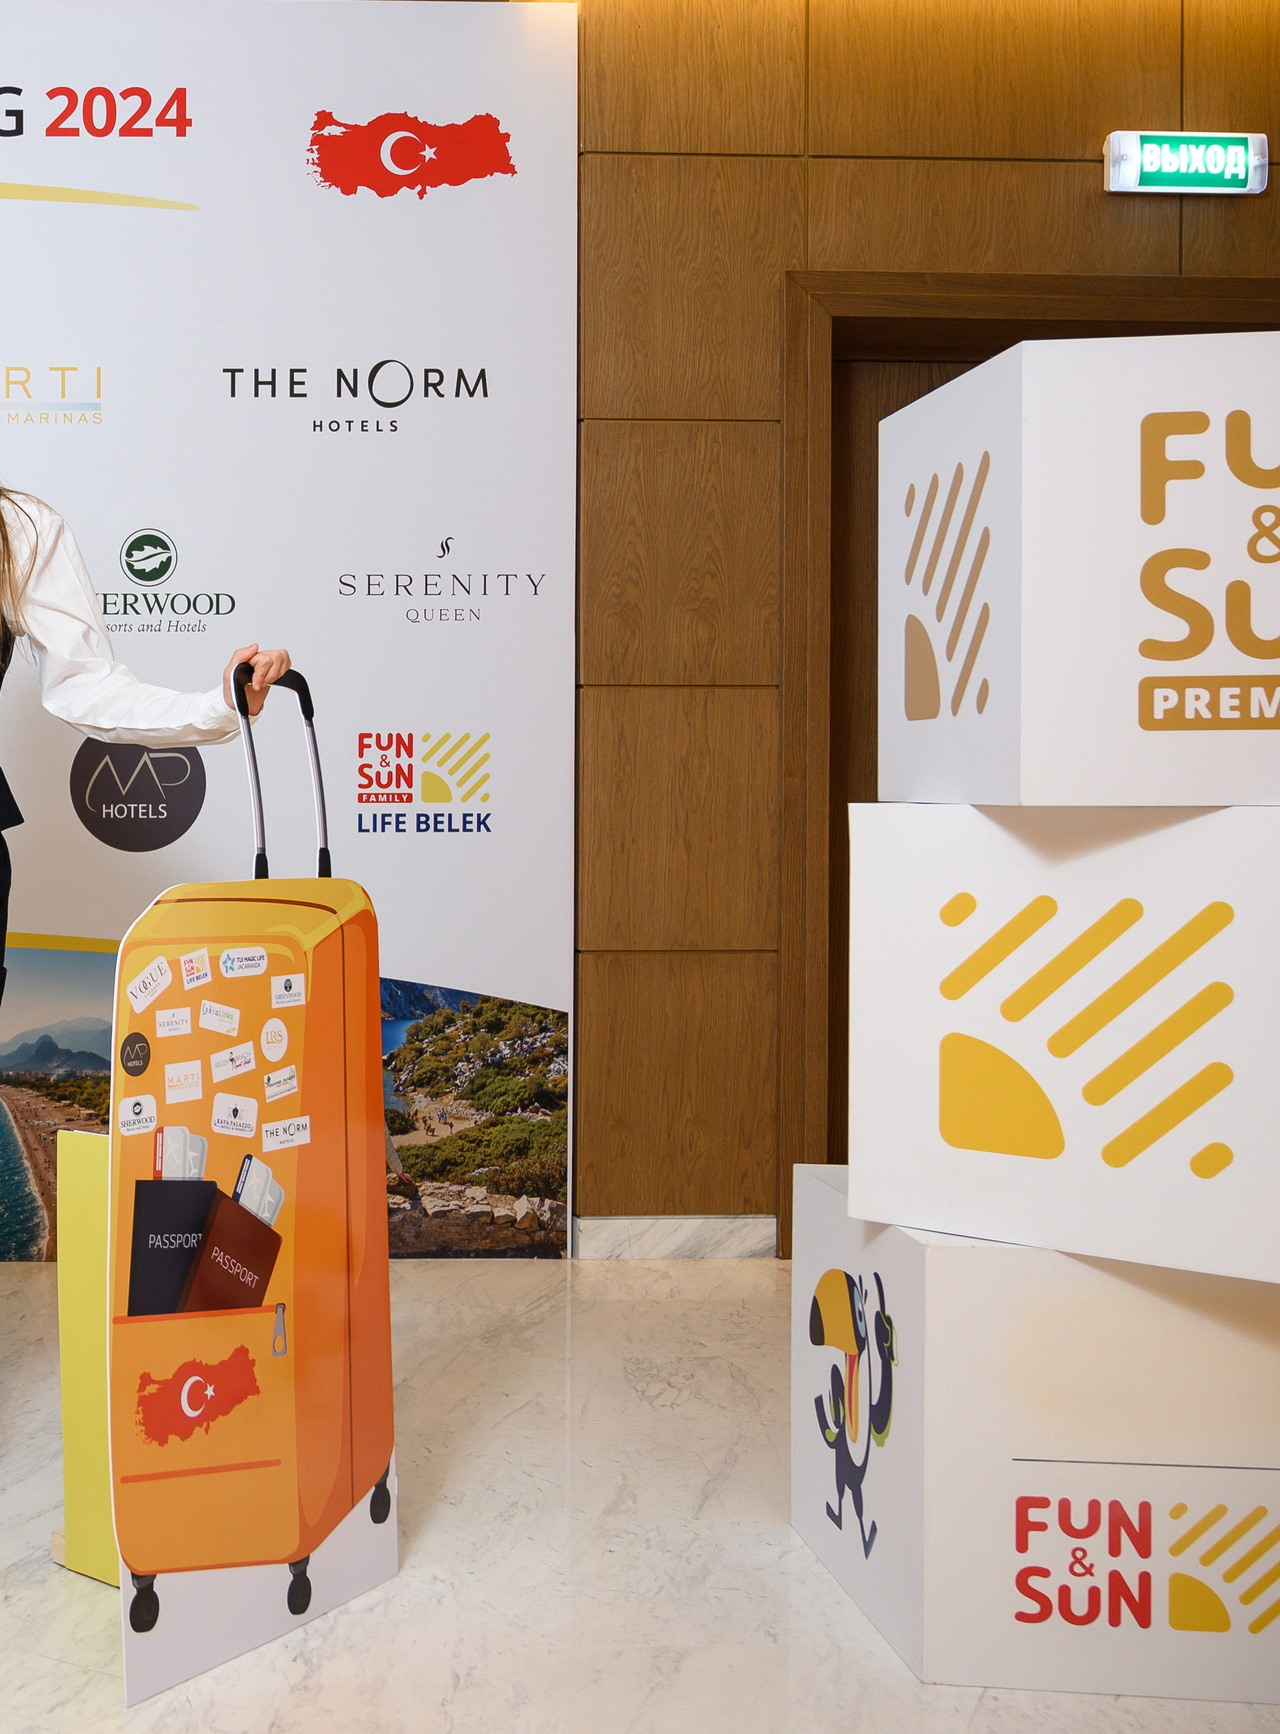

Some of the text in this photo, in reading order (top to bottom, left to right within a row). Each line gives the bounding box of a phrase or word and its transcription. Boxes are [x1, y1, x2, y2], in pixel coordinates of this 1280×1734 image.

[45, 87, 193, 138] 2024
[1143, 143, 1247, 179] ВЫХОД
[223, 359, 489, 409] THE NORM
[8, 413, 103, 424] MARINAS
[312, 420, 400, 432] HOTELS
[1140, 409, 1280, 526] FU
[338, 574, 547, 597] SERENITY
[96, 593, 236, 616] ERWOOD
[1138, 547, 1280, 661] SU
[105, 619, 207, 633] sorts and Hotels
[405, 608, 481, 624] QUEEN
[1154, 688, 1280, 719] PREM
[358, 733, 413, 760] FUN
[380, 754, 391, 768] &
[86, 750, 191, 813] MP
[357, 763, 413, 789] SUN
[362, 794, 410, 802] FAMILY
[102, 803, 167, 820] HOTELS
[358, 813, 492, 833] LIFE BELEK
[130, 962, 167, 1000] VOGUE
[158, 1019, 188, 1027] SERENITY
[266, 1030, 283, 1045] LRS
[124, 1043, 148, 1066] MP
[168, 1073, 199, 1085] MARTI
[120, 1116, 155, 1128] SHERWOOD
[265, 1123, 308, 1138] THE NORM
[210, 1247, 260, 1289] PASSPORT
[1016, 1496, 1152, 1559] FUN
[1069, 1547, 1095, 1577] &
[1015, 1565, 1152, 1629] SUN
